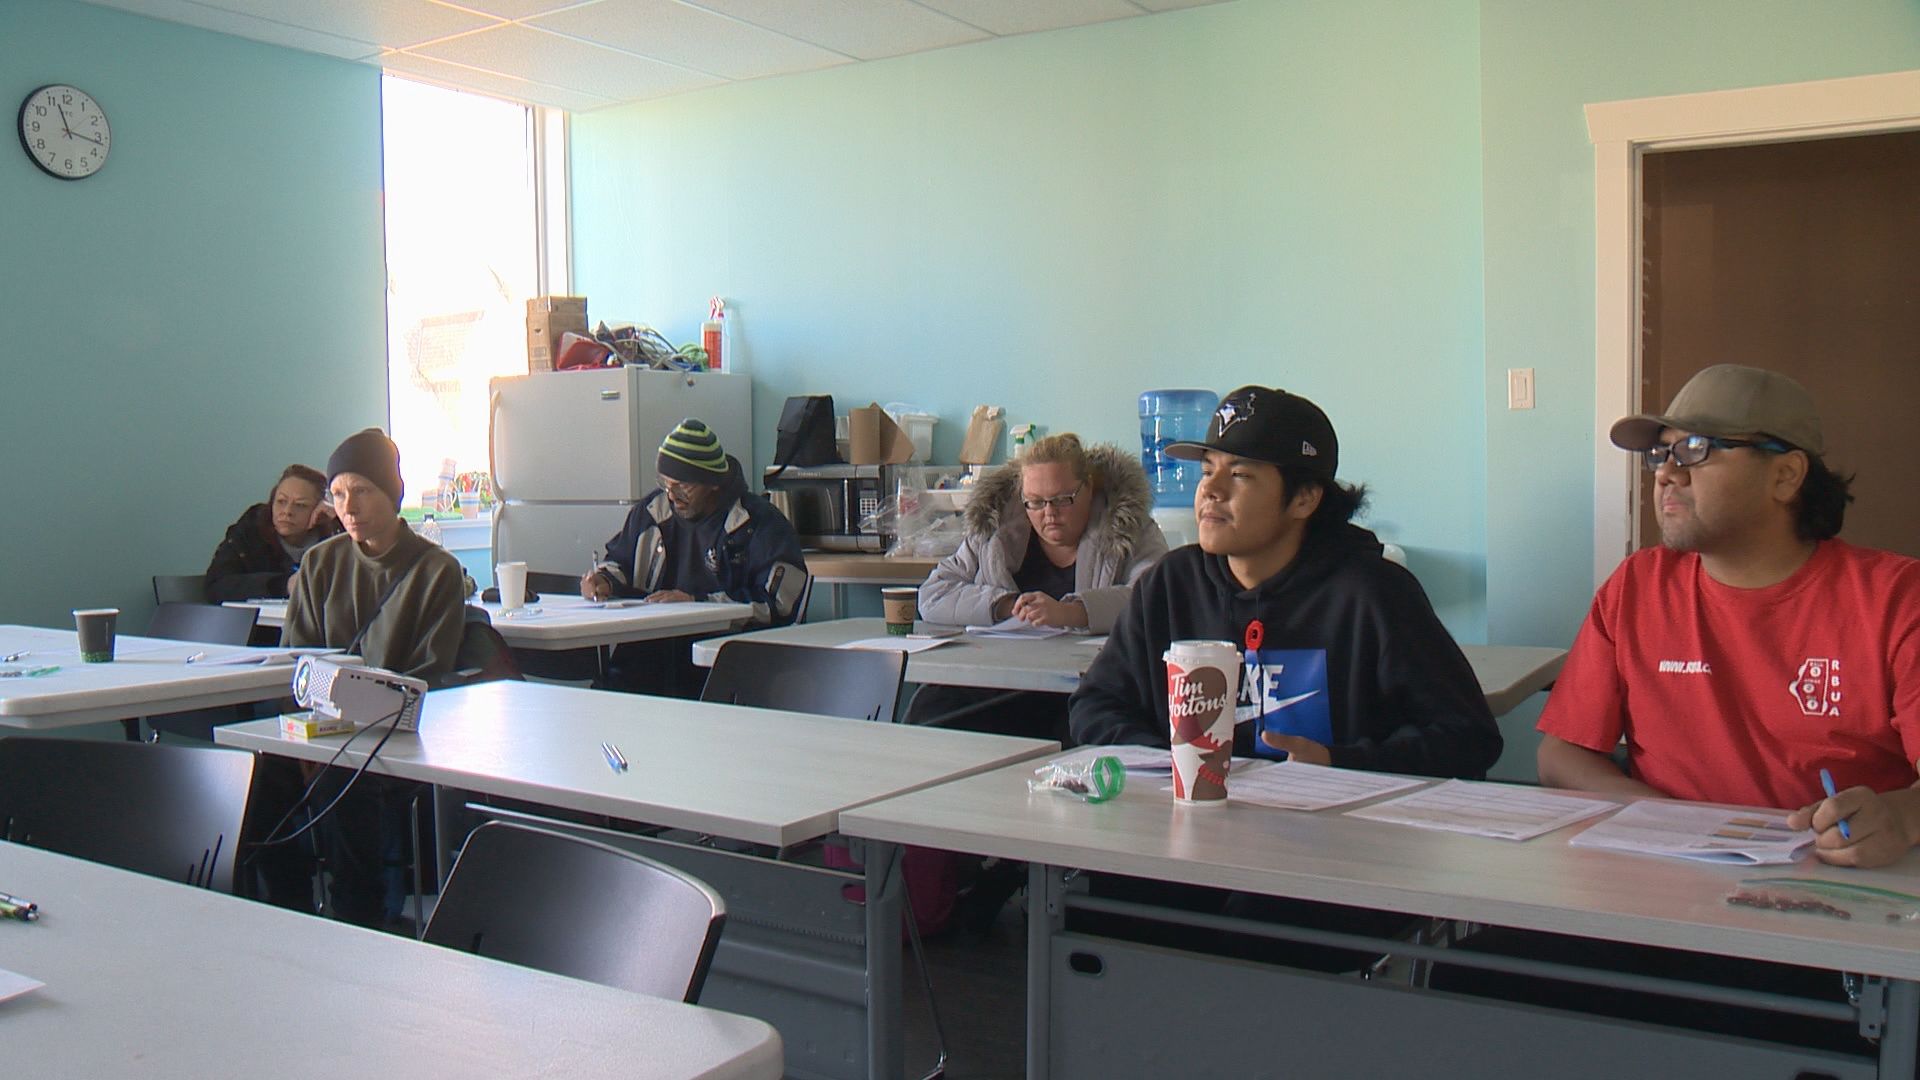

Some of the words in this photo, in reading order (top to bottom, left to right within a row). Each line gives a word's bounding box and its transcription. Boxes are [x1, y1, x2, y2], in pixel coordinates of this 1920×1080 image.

[48, 96, 56, 106] 11
[62, 95, 72, 105] 12
[36, 106, 47, 116] 10
[81, 102, 85, 112] 1
[91, 116, 98, 126] 2
[32, 122, 40, 131] 9
[95, 133, 101, 142] 3
[37, 139, 45, 149] 8
[49, 152, 56, 162] 7
[91, 148, 97, 158] 4
[65, 159, 72, 169] 6
[81, 157, 87, 167] 5
[1171, 674, 1203, 696] Tim
[1236, 664, 1284, 704] KE
